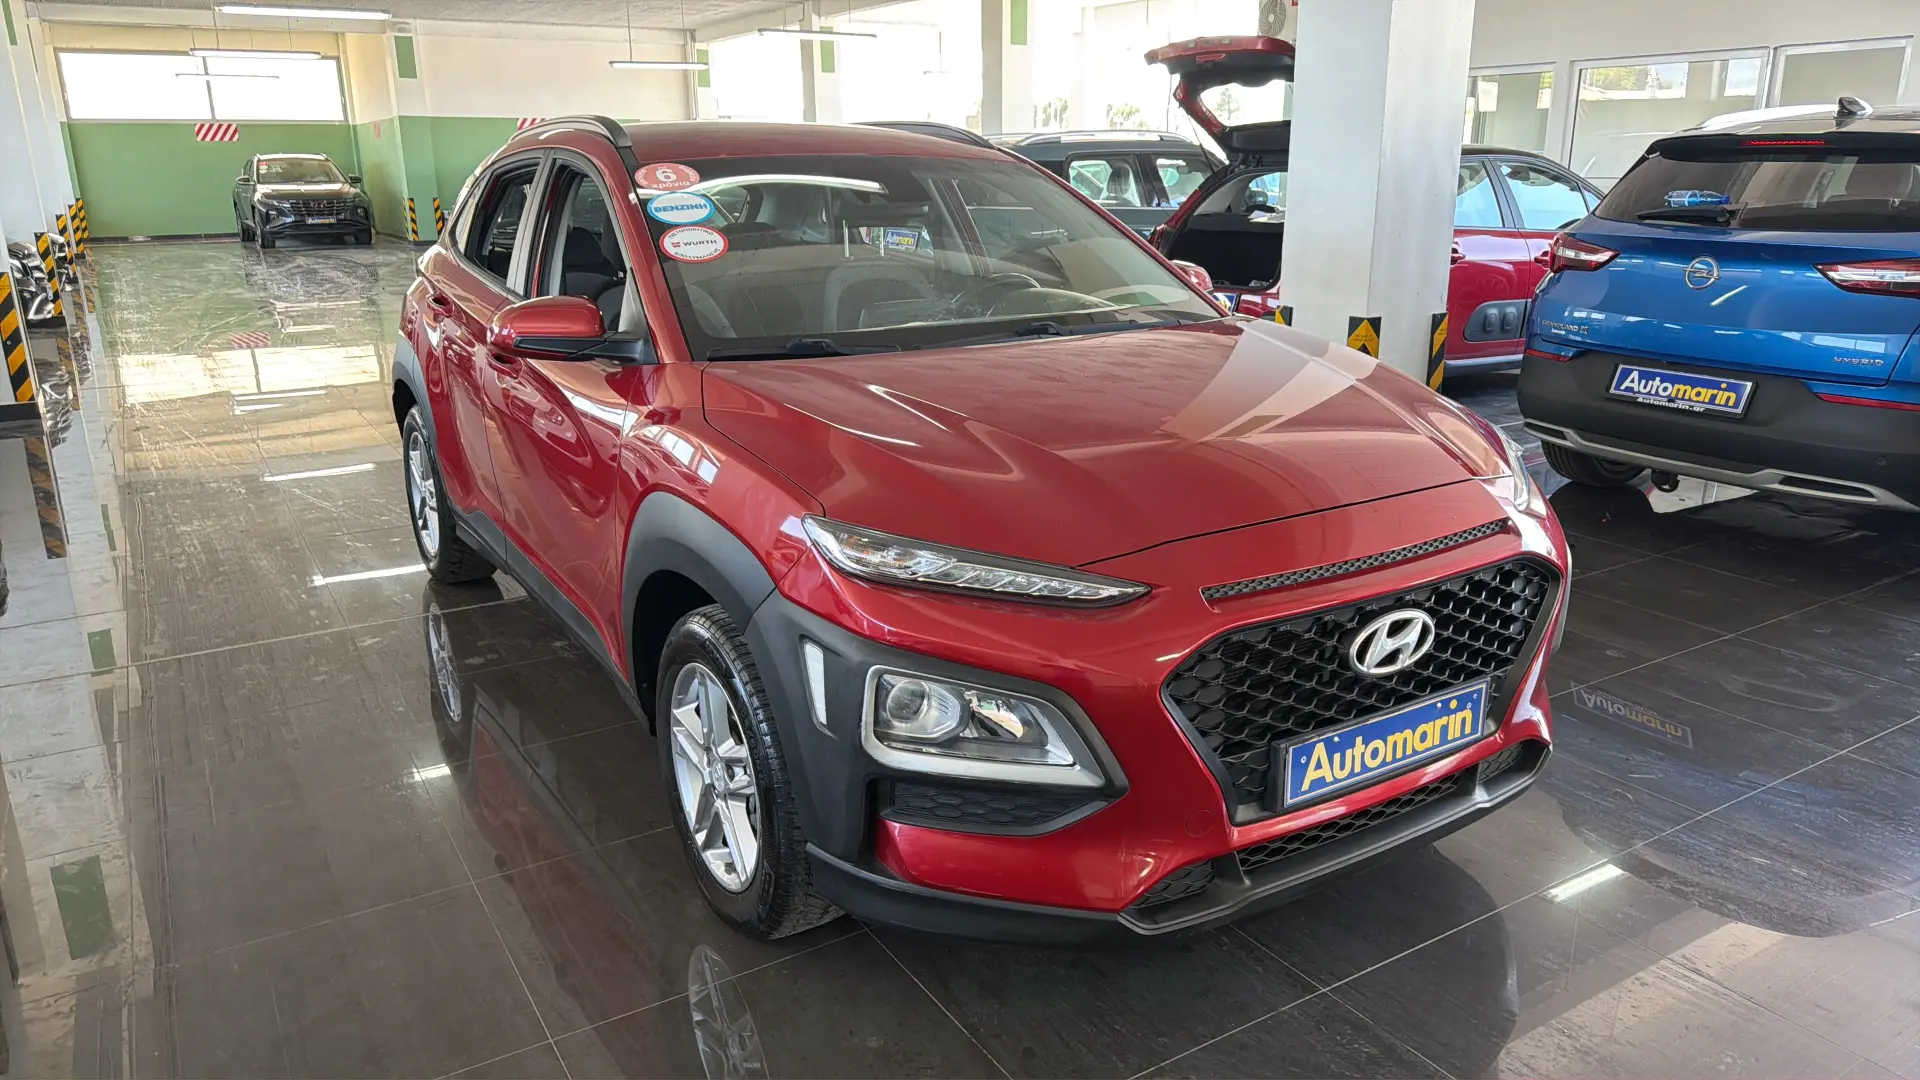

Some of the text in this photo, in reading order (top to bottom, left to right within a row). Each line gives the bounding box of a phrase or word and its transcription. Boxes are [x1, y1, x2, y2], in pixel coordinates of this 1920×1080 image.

[656, 168, 677, 182] 6
[1579, 325, 1589, 335] X
[1832, 356, 1884, 366] HYBRID
[1619, 370, 1737, 407] Automarin
[1300, 698, 1473, 792] Automarin
